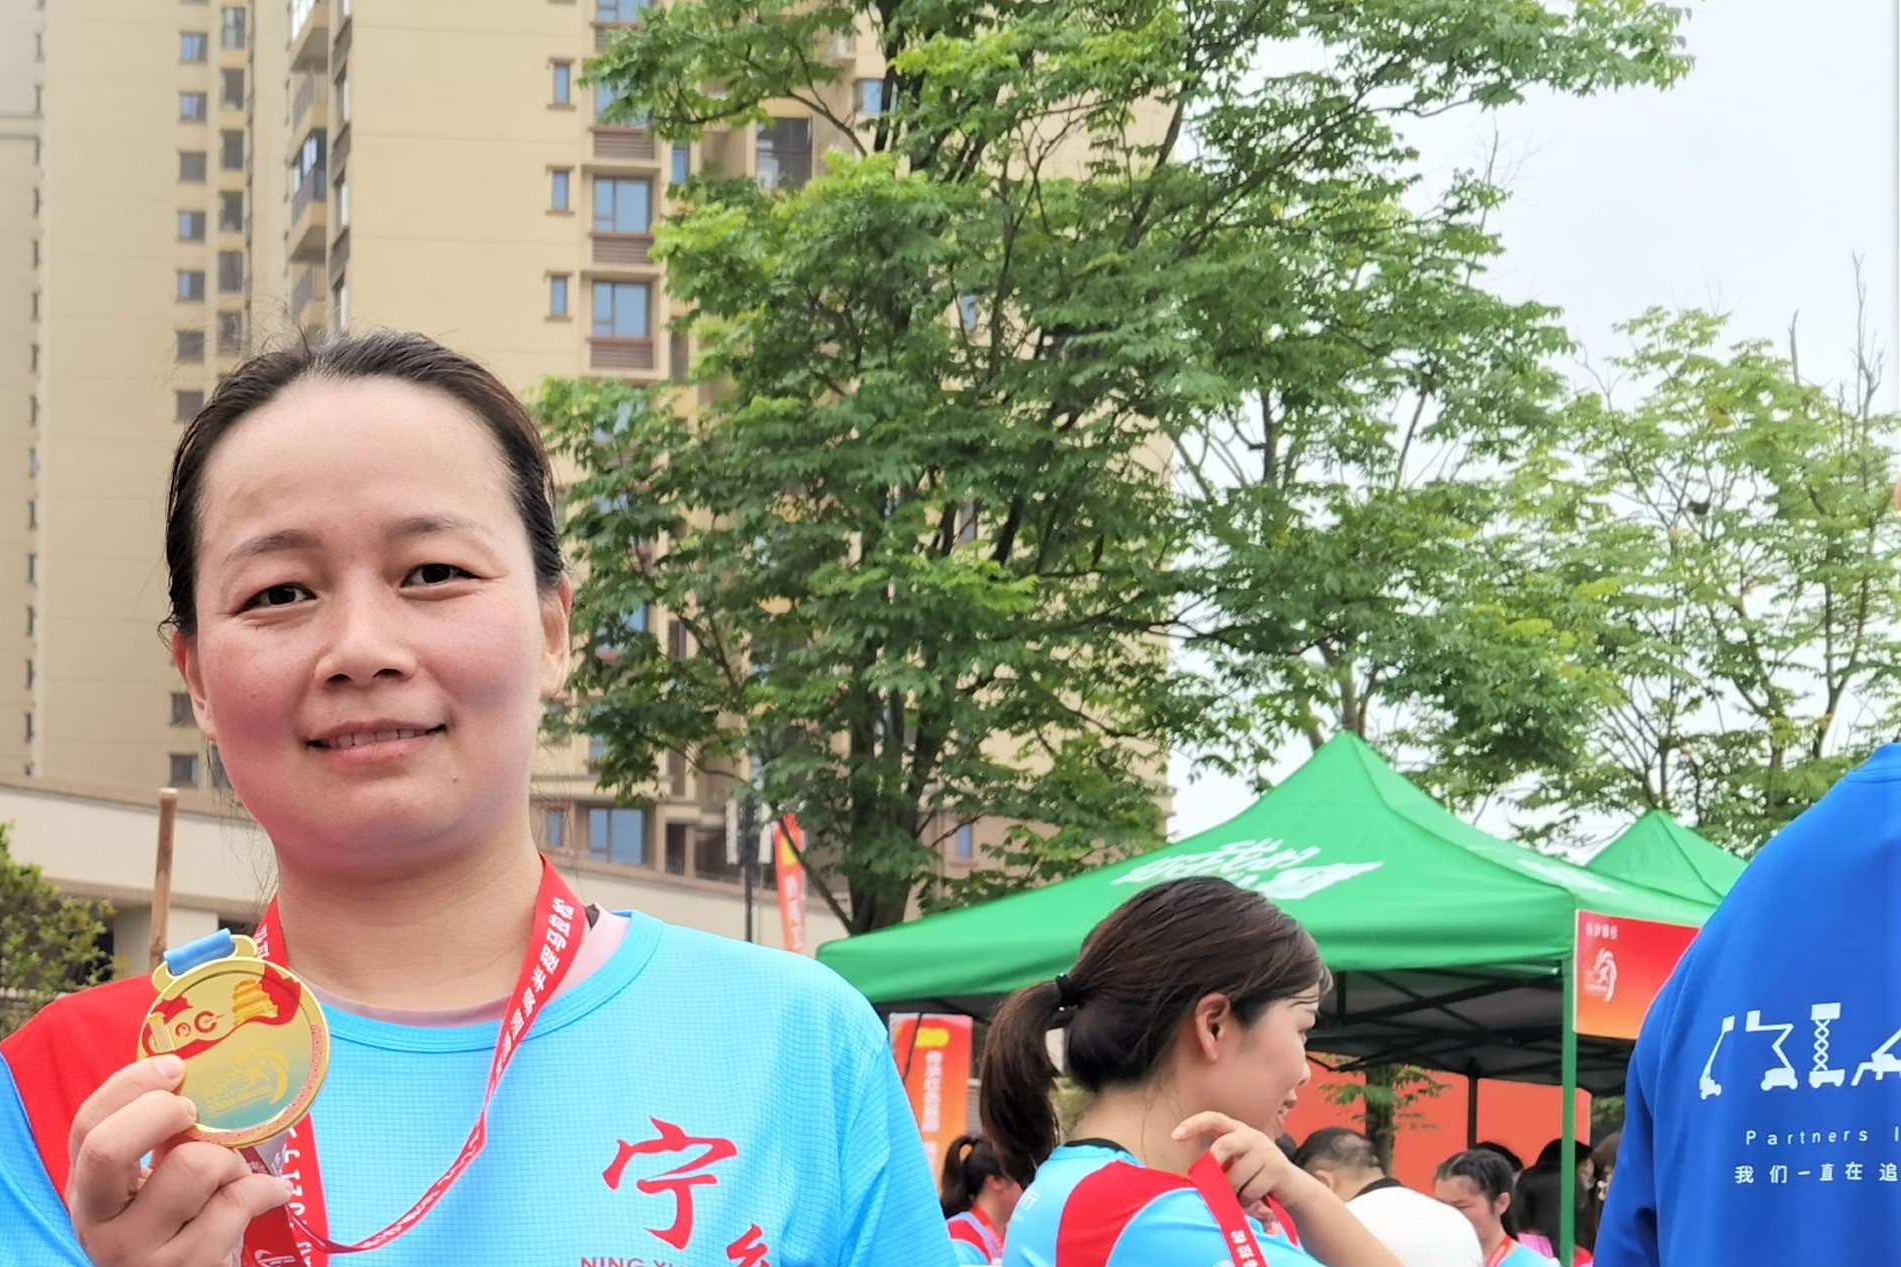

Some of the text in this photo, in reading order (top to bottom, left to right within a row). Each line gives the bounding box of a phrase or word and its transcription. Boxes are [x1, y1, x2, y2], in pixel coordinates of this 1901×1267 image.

[1745, 1129, 1869, 1146] Partners
[1734, 1161, 1899, 1185] 我们一直在追
